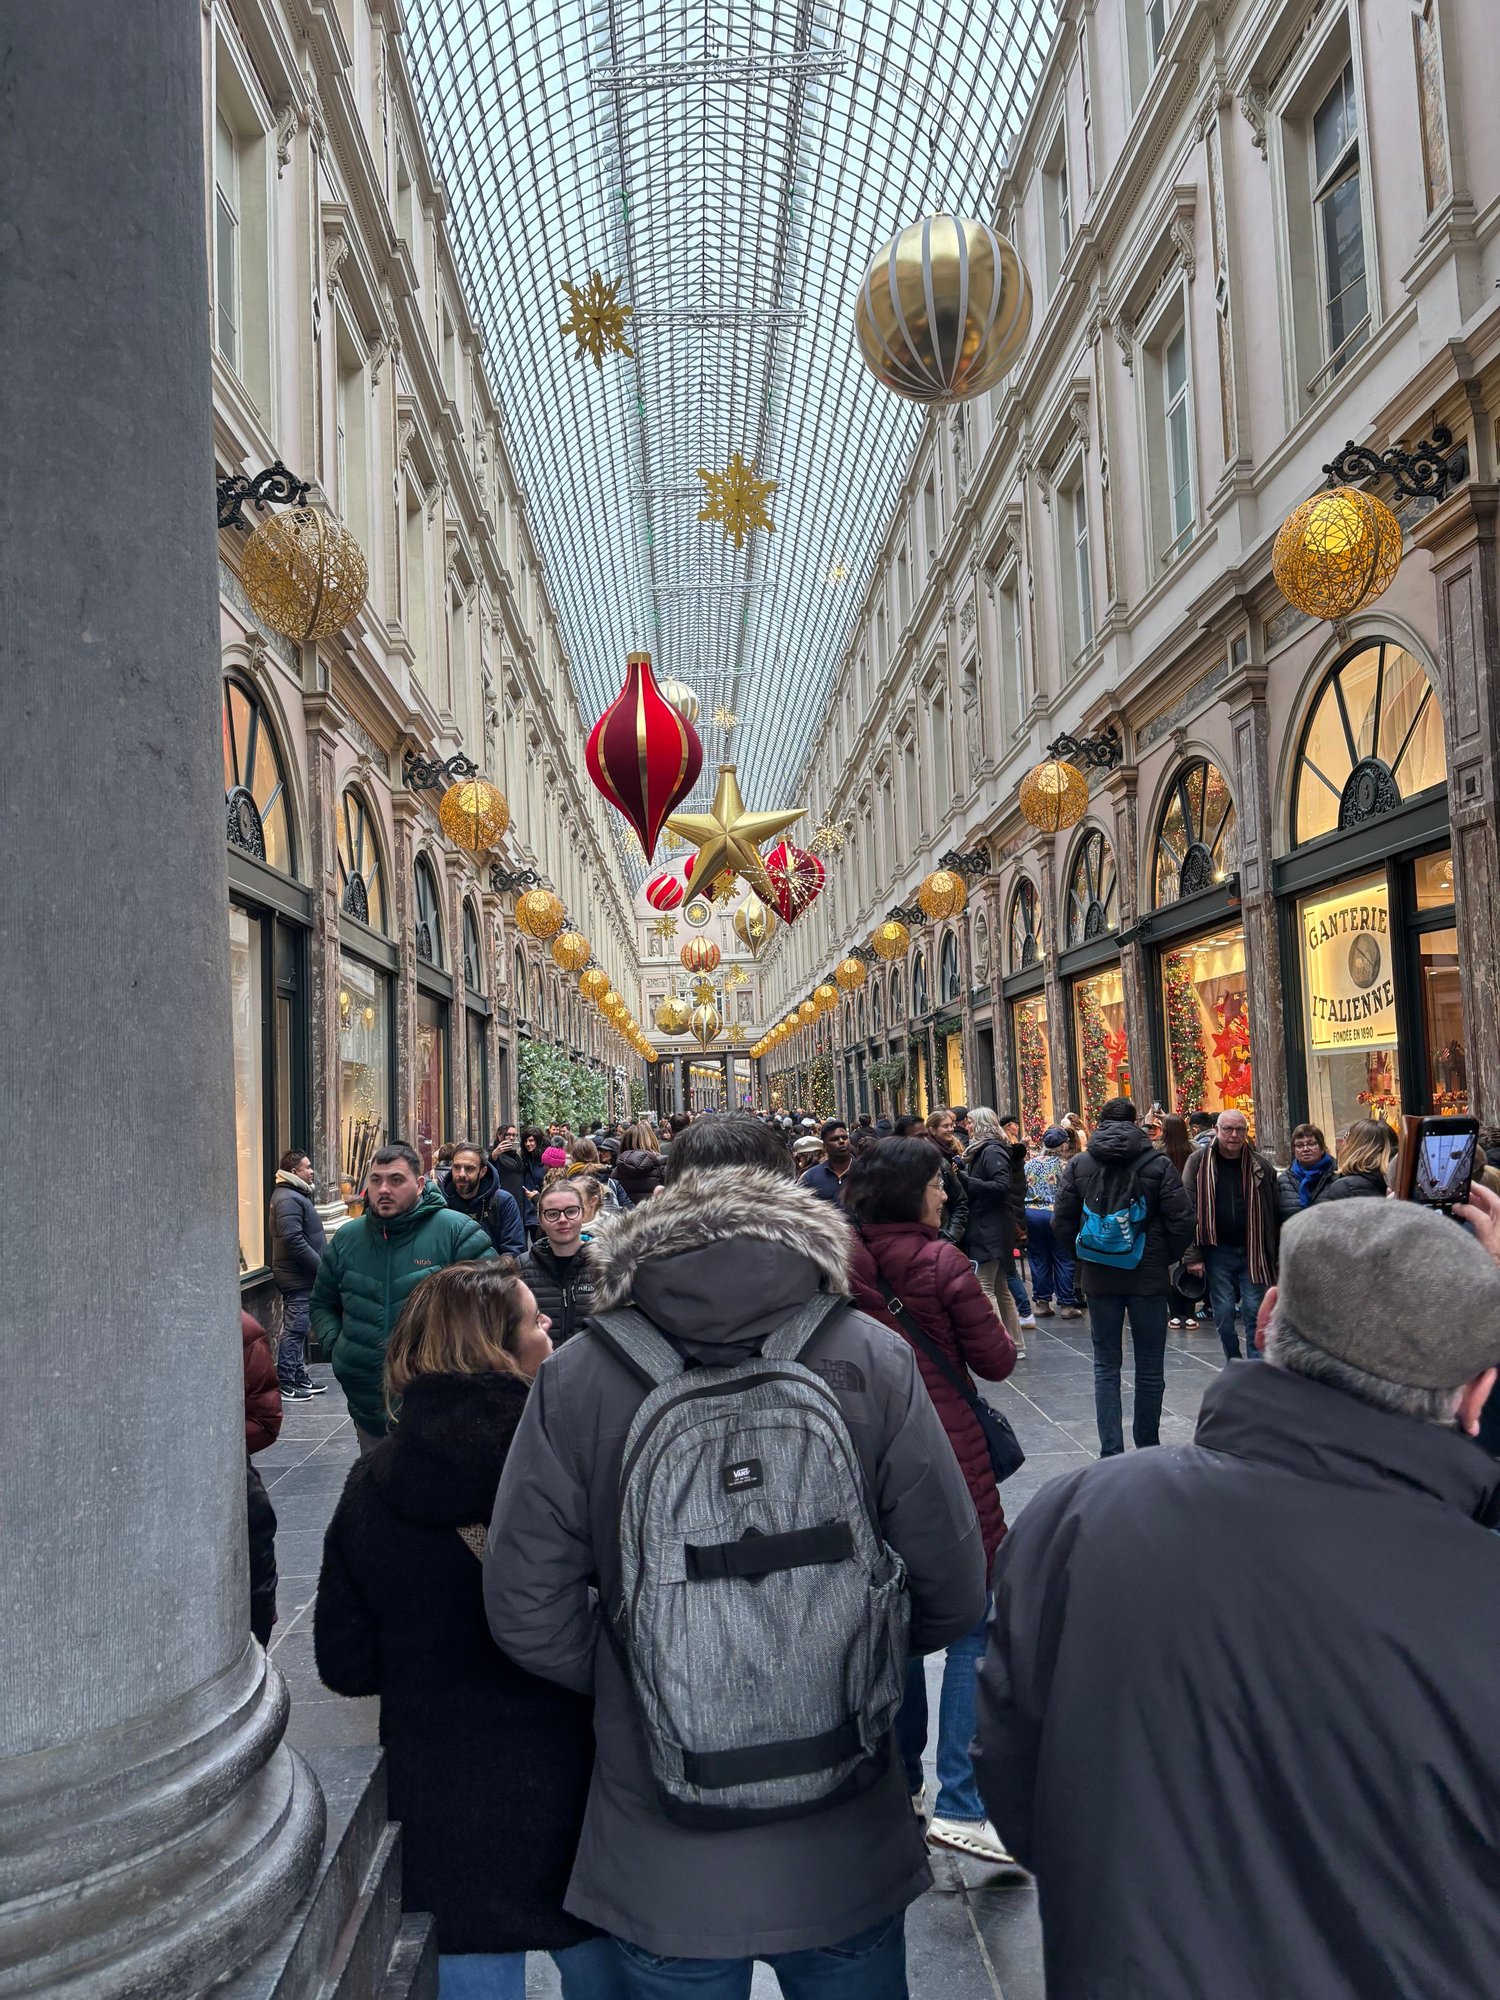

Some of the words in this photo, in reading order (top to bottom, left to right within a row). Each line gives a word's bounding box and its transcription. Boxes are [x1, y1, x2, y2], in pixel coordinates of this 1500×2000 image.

[1309, 906, 1388, 950] GANTERIE
[1312, 979, 1394, 1023] ITALIENNE
[1333, 1028, 1353, 1043] FONDÉE
[1353, 1029, 1360, 1040] EN
[1360, 1026, 1374, 1039] 1890
[821, 1358, 846, 1370] THE
[733, 1467, 750, 1478] VANS
